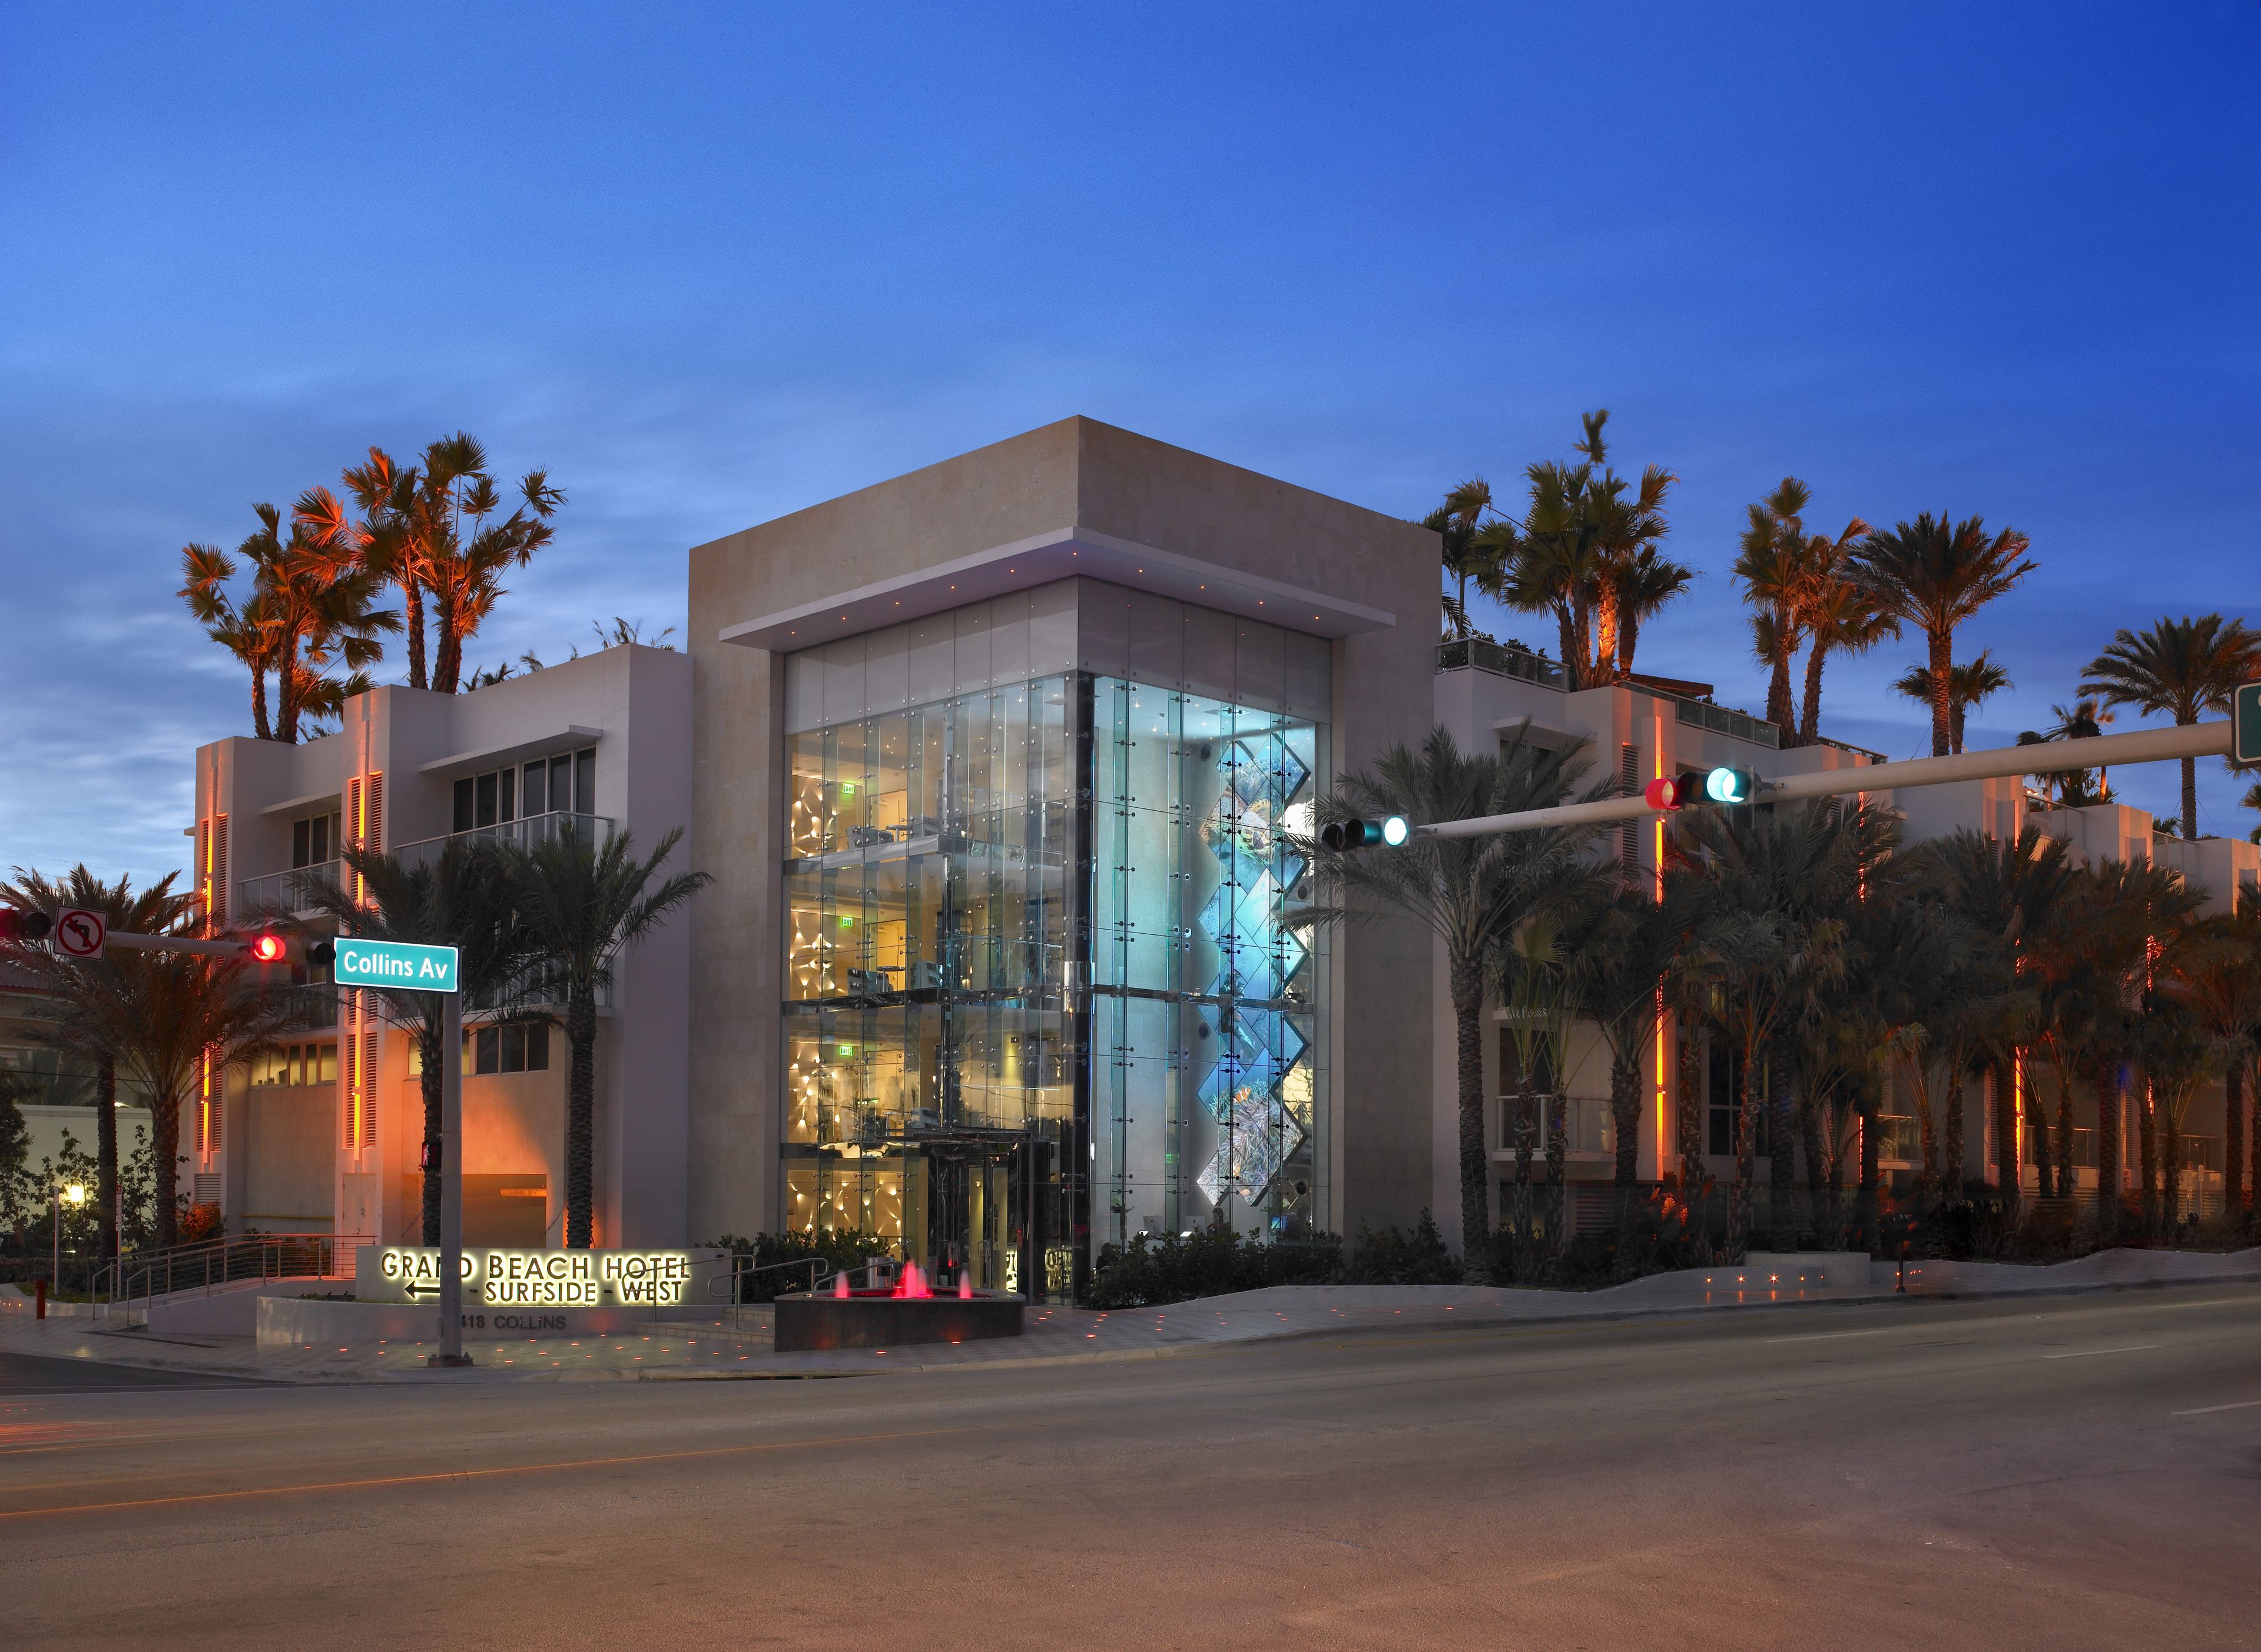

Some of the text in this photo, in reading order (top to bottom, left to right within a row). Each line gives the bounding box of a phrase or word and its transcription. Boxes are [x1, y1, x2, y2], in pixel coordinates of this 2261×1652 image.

[344, 951, 448, 979] Collins Av
[382, 1252, 690, 1279] GRAD BEACH HOTEL
[485, 1281, 682, 1302] SURFSIDE WEST
[493, 1315, 566, 1329] COLLINS
